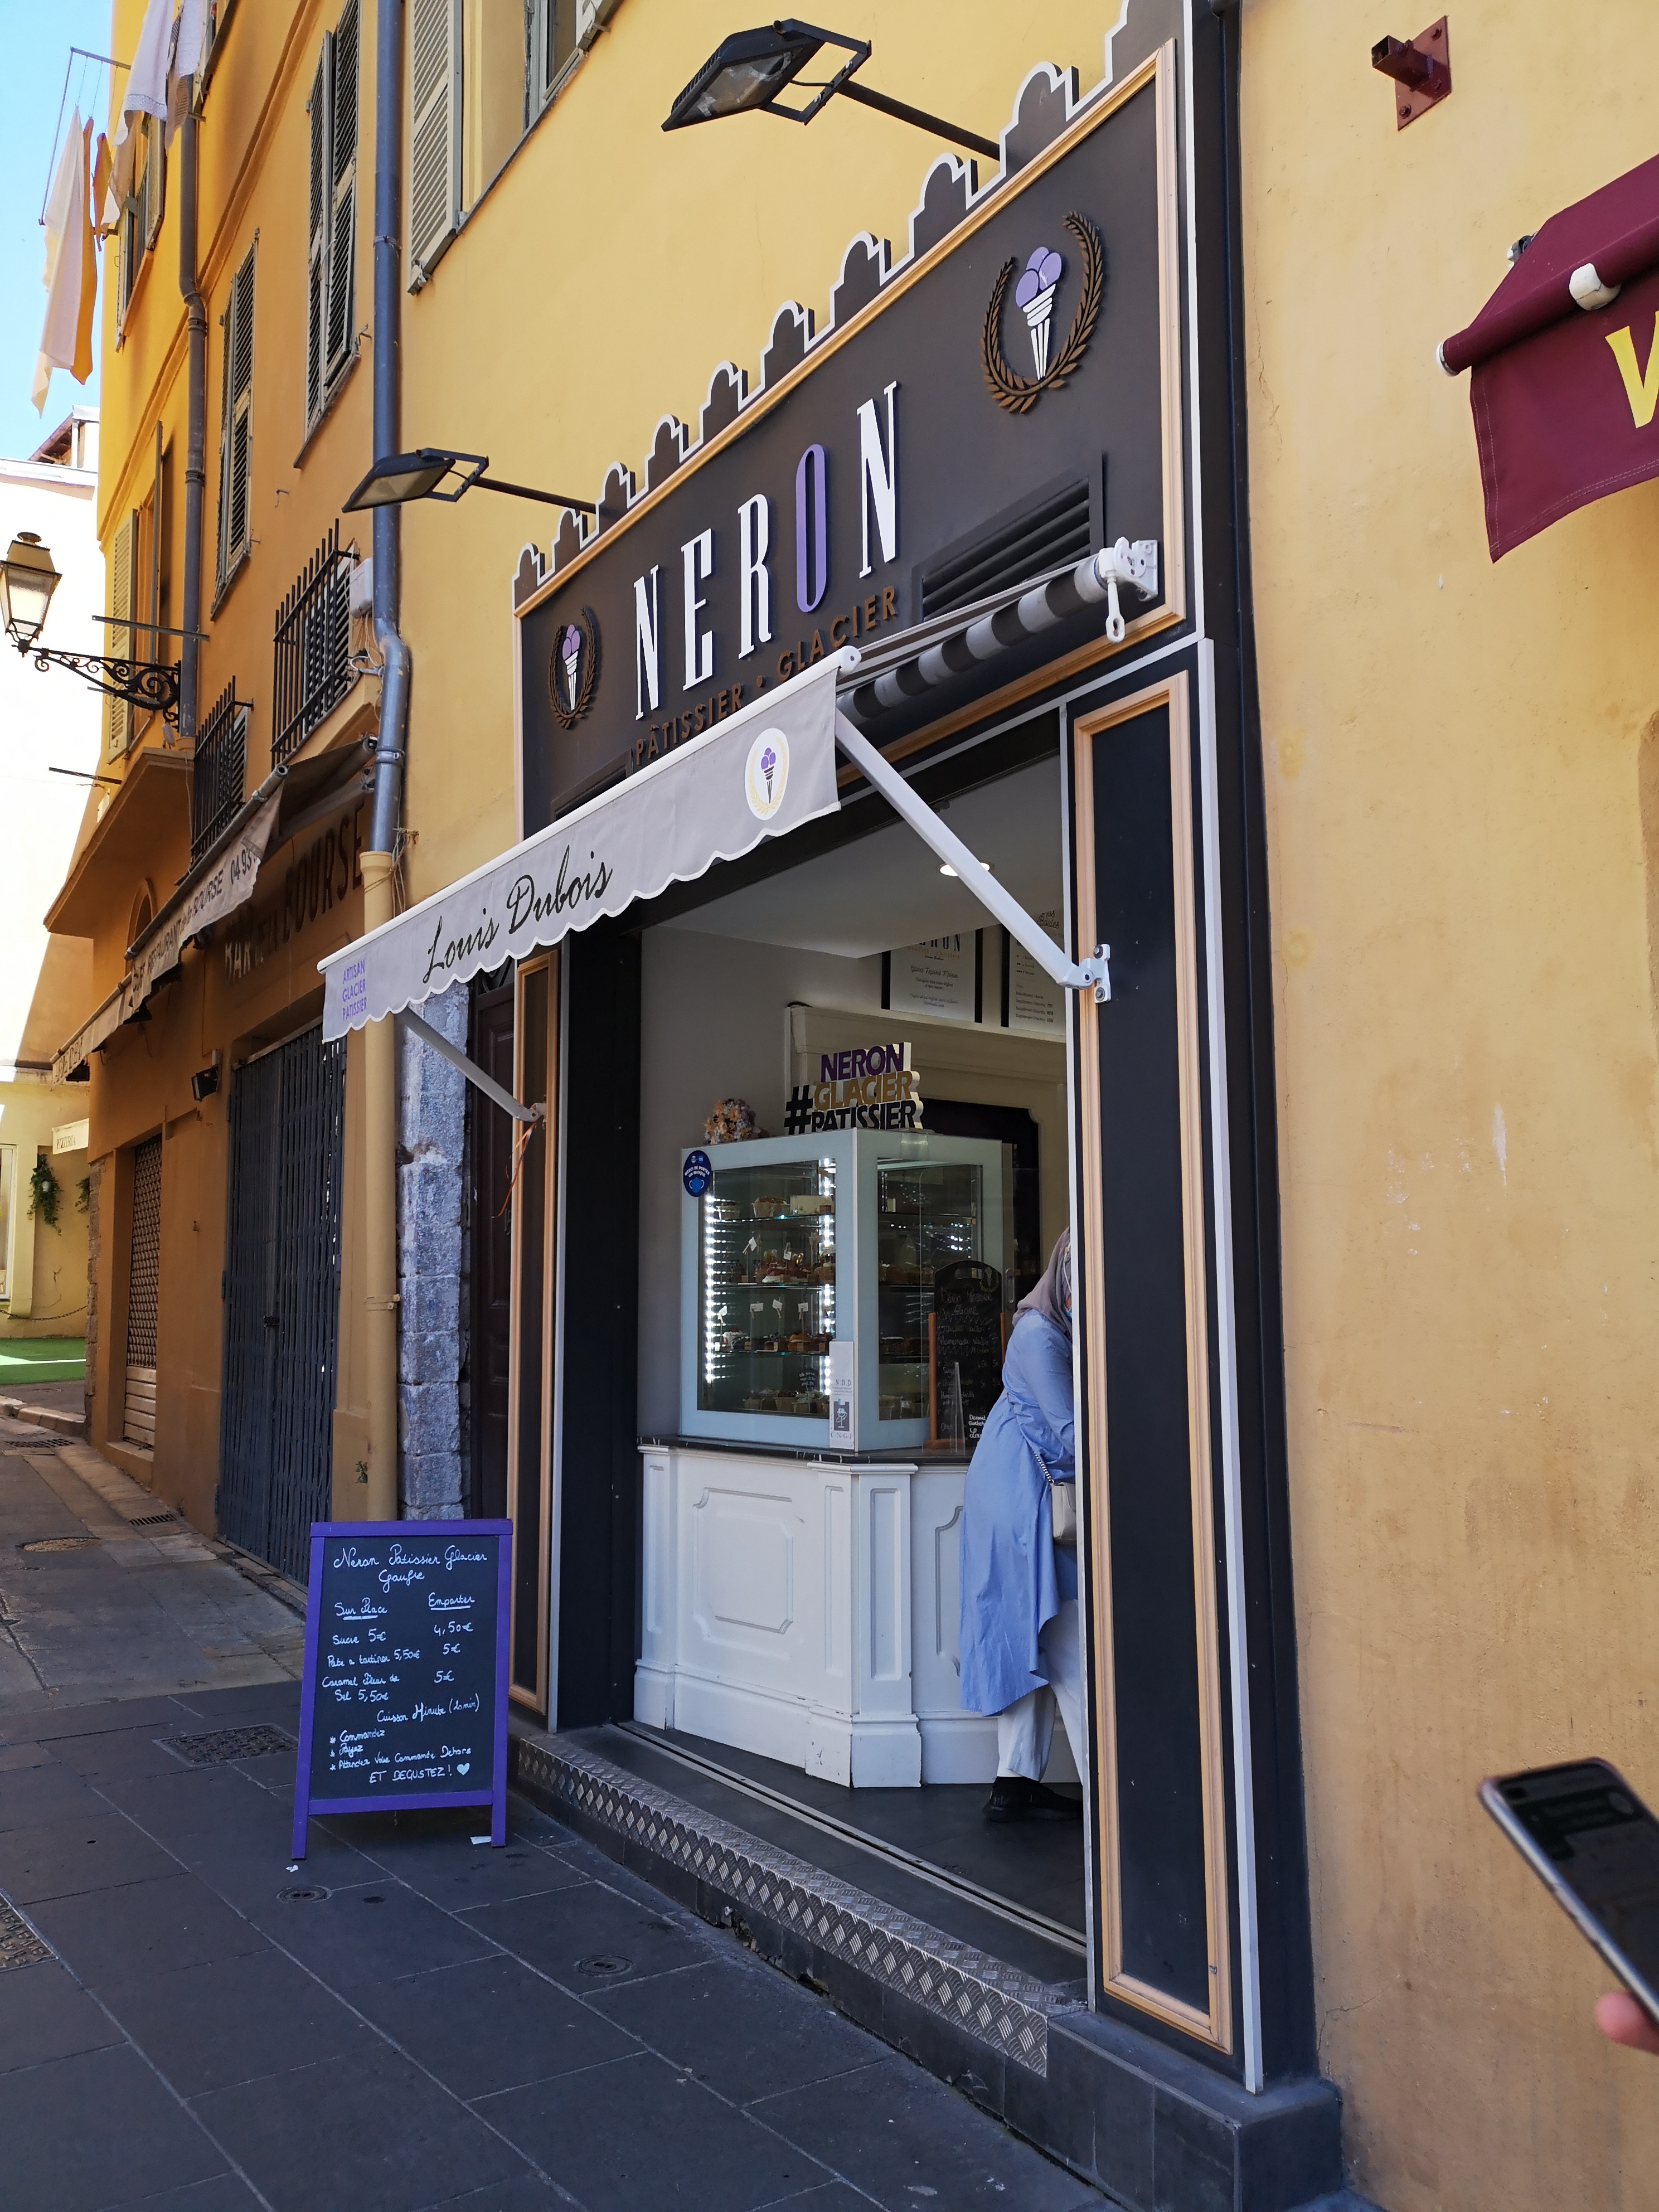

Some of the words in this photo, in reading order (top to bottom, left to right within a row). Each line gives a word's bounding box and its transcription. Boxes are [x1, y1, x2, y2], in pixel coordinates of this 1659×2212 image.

[633, 380, 898, 720] NERON
[636, 682, 744, 765] PÂTISSIER
[777, 586, 896, 682] GLACIER
[230, 855, 240, 885] 04
[241, 848, 252, 875] 93
[422, 908, 499, 983] Louis
[506, 845, 613, 934] Dubois
[342, 959, 365, 984] ARTISAN
[342, 978, 366, 1002] GLACIER
[342, 997, 367, 1022] PATISSIER
[821, 1042, 905, 1083] NERON
[814, 1070, 913, 1111] GLACIER
[56, 1136, 76, 1150] PIZZERIA
[389, 1544, 440, 1565] Patissier
[444, 1545, 488, 1570] Glacier
[378, 1569, 425, 1593] Gaufre
[334, 1602, 356, 1616] Sur
[361, 1597, 387, 1614] Place
[332, 1634, 360, 1645] Sucre
[368, 1628, 386, 1642] 5€
[434, 1621, 474, 1637] 4,50€
[394, 1648, 420, 1661] 5,50€
[442, 1643, 461, 1655] 5€
[322, 1676, 358, 1688] Caramel
[362, 1672, 386, 1686] Fleur
[390, 1673, 400, 1682] de
[434, 1670, 455, 1684] 5€
[334, 1689, 352, 1701] Sel
[358, 1689, 389, 1702] 5,50€
[377, 1710, 409, 1723] Cuisson
[412, 1702, 446, 1723] Minute
[339, 1728, 385, 1743] Commandez
[338, 1743, 364, 1758] Payez
[338, 1758, 371, 1770] Attendez
[395, 1750, 436, 1763] Commande
[440, 1745, 472, 1758] Dehors
[369, 1770, 387, 1783] ET
